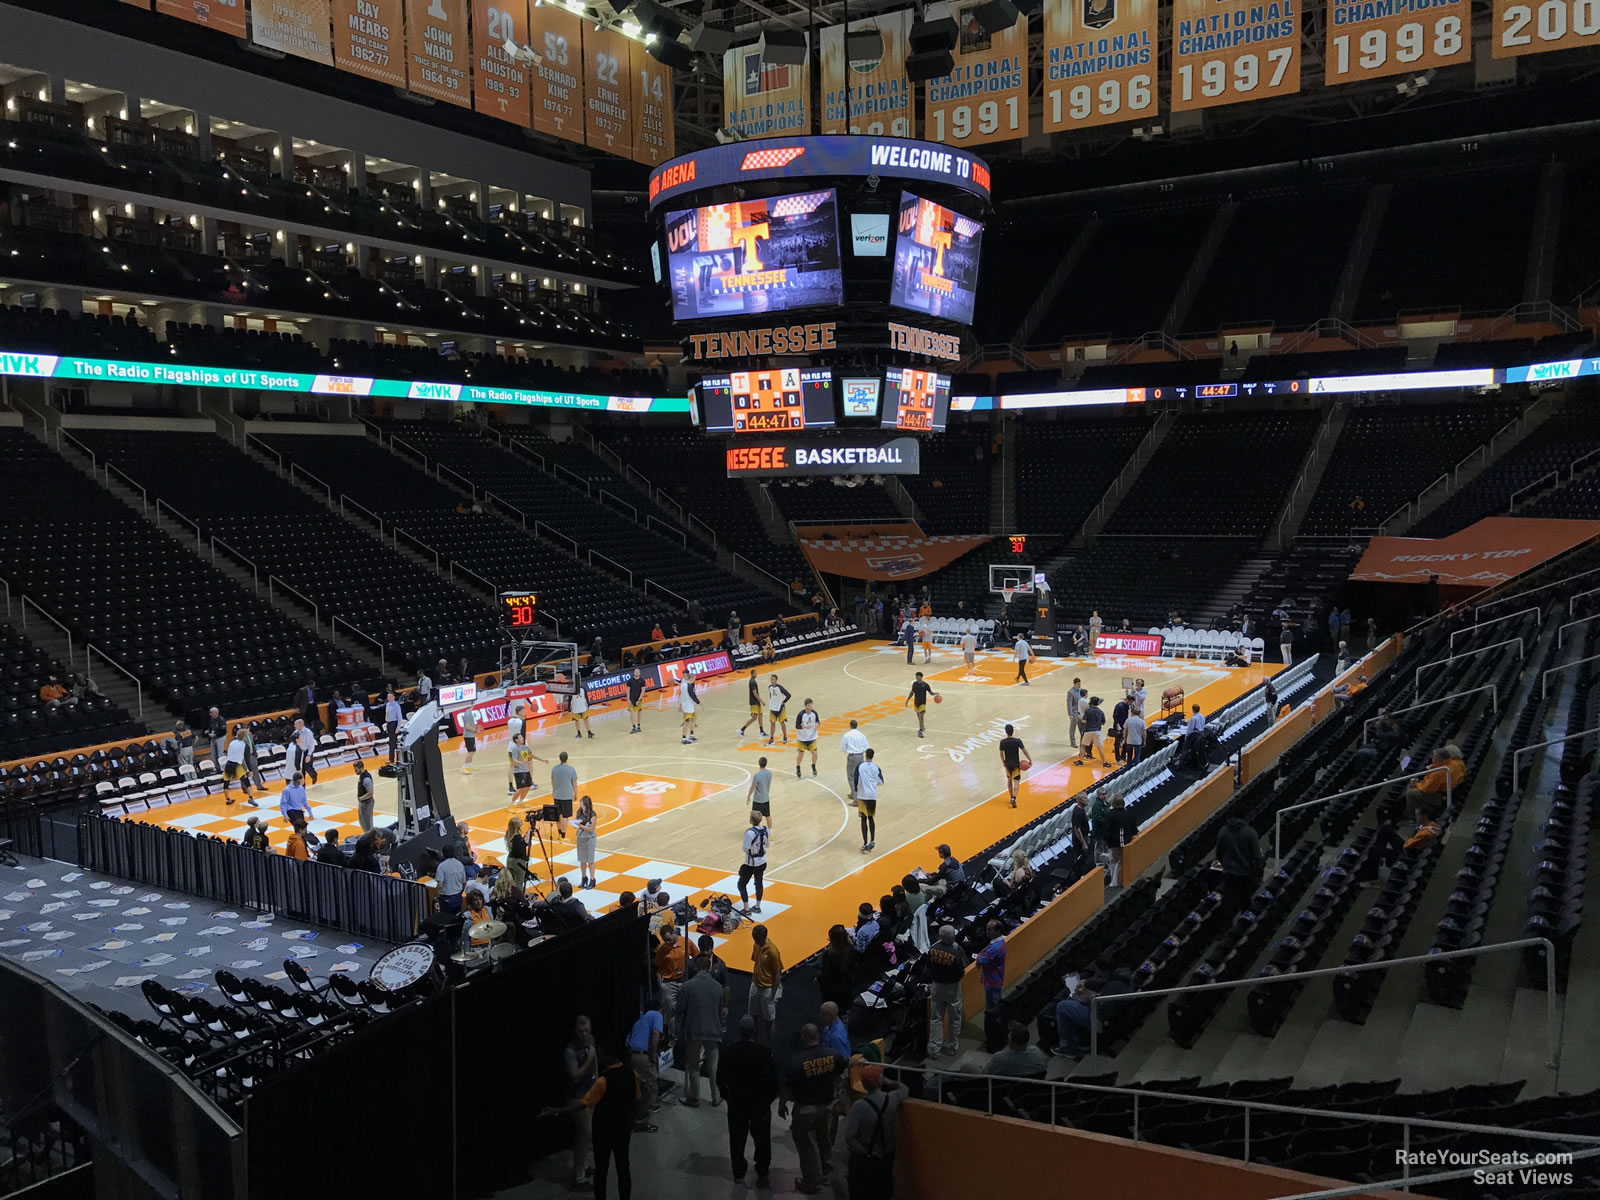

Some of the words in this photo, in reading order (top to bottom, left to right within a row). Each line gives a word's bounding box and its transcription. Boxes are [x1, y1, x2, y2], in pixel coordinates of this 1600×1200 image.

[357, 0, 380, 20] RAY
[1179, 0, 1295, 38] NATIONAL
[348, 13, 390, 41] MEARS
[487, 6, 514, 43] 20
[258, 26, 330, 57] CHAMPIONSHIPS
[351, 33, 367, 46] HEAD
[367, 39, 389, 53] COACH
[423, 25, 453, 47] JOHN
[1178, 18, 1294, 56] CHAMPIONS
[1334, 15, 1463, 74] 1998
[350, 44, 389, 67] 1962-77
[423, 41, 454, 63] WARD
[544, 31, 569, 66] 53
[1049, 30, 1152, 65] NATIONAL
[480, 58, 524, 84] HOUSTON
[596, 52, 618, 86] 22
[930, 56, 1022, 86] NATIONAL
[1048, 48, 1152, 82] CHAMPIONS
[1178, 46, 1293, 101] 1997
[420, 67, 459, 90] 1964-99
[538, 64, 577, 88] BERNARD
[640, 69, 664, 102] 14
[485, 78, 520, 99] 1989-93
[548, 82, 569, 100] KING
[598, 87, 620, 105] ERNIE
[826, 78, 910, 106] NATIONAL
[930, 72, 1022, 102] CHAMPIONS
[544, 98, 573, 117] 1974-77
[589, 98, 627, 120] GRUNFELD
[826, 94, 909, 121] CHAMPIONS
[1048, 74, 1152, 124] 1996
[644, 104, 663, 118] DALE
[729, 98, 805, 125] NATIONAL
[932, 96, 1019, 143] 1991
[596, 116, 622, 134] 1973-77
[643, 116, 664, 134] ELLIS
[1459, 142, 1479, 153] 314
[871, 144, 952, 174] WELCOME
[956, 157, 970, 178] TO
[1318, 162, 1334, 172] 313
[661, 160, 697, 191] ARENA
[1159, 184, 1174, 193] 312
[624, 196, 638, 205] 309
[732, 222, 770, 271] T
[855, 234, 886, 243] verizon
[932, 230, 953, 276] T
[714, 281, 796, 296] BASKETBALL
[720, 269, 787, 290] TENNESSEE
[920, 274, 953, 293] TENNESSEE
[916, 282, 956, 299] BASKETBALL
[690, 322, 837, 360] TENNESSEE
[888, 322, 960, 362] TENNESSEE
[74, 361, 102, 375] The
[106, 364, 150, 378] Radio
[154, 366, 220, 384] Flagships
[224, 372, 236, 384] of
[240, 373, 256, 386] UT
[260, 374, 300, 388] Sports
[786, 372, 796, 387] A
[1154, 388, 1162, 399] 0
[1202, 386, 1230, 396] 44:47
[1290, 382, 1298, 392] 0
[1316, 380, 1325, 392] A
[470, 388, 486, 400] The
[488, 390, 512, 402] Radio
[514, 392, 552, 404] Flagships
[554, 396, 563, 405] of
[564, 396, 574, 406] UT
[576, 398, 600, 408] Sports
[739, 398, 746, 408] 0
[774, 398, 780, 406] 4
[788, 394, 796, 404] 0
[749, 414, 787, 429] 44:47
[906, 414, 926, 428] 44:47
[795, 448, 902, 465] BASKETBALL
[1012, 542, 1024, 552] 30
[1390, 552, 1478, 562] ROCKY
[1480, 548, 1533, 560] TOP
[506, 595, 536, 606] 44:47
[512, 606, 532, 625] 30
[1038, 608, 1048, 618] T
[1095, 636, 1122, 650] CPI
[1122, 638, 1158, 652] SECURITY
[666, 664, 682, 680] T
[686, 660, 708, 676] CPI
[706, 656, 728, 672] SECURITY
[586, 678, 622, 690] WELCOME
[622, 673, 632, 682] TO
[442, 692, 455, 700] FOOD
[930, 948, 956, 962] EVENT
[802, 1056, 834, 1070] EVENT
[805, 1064, 834, 1077] STAFF
